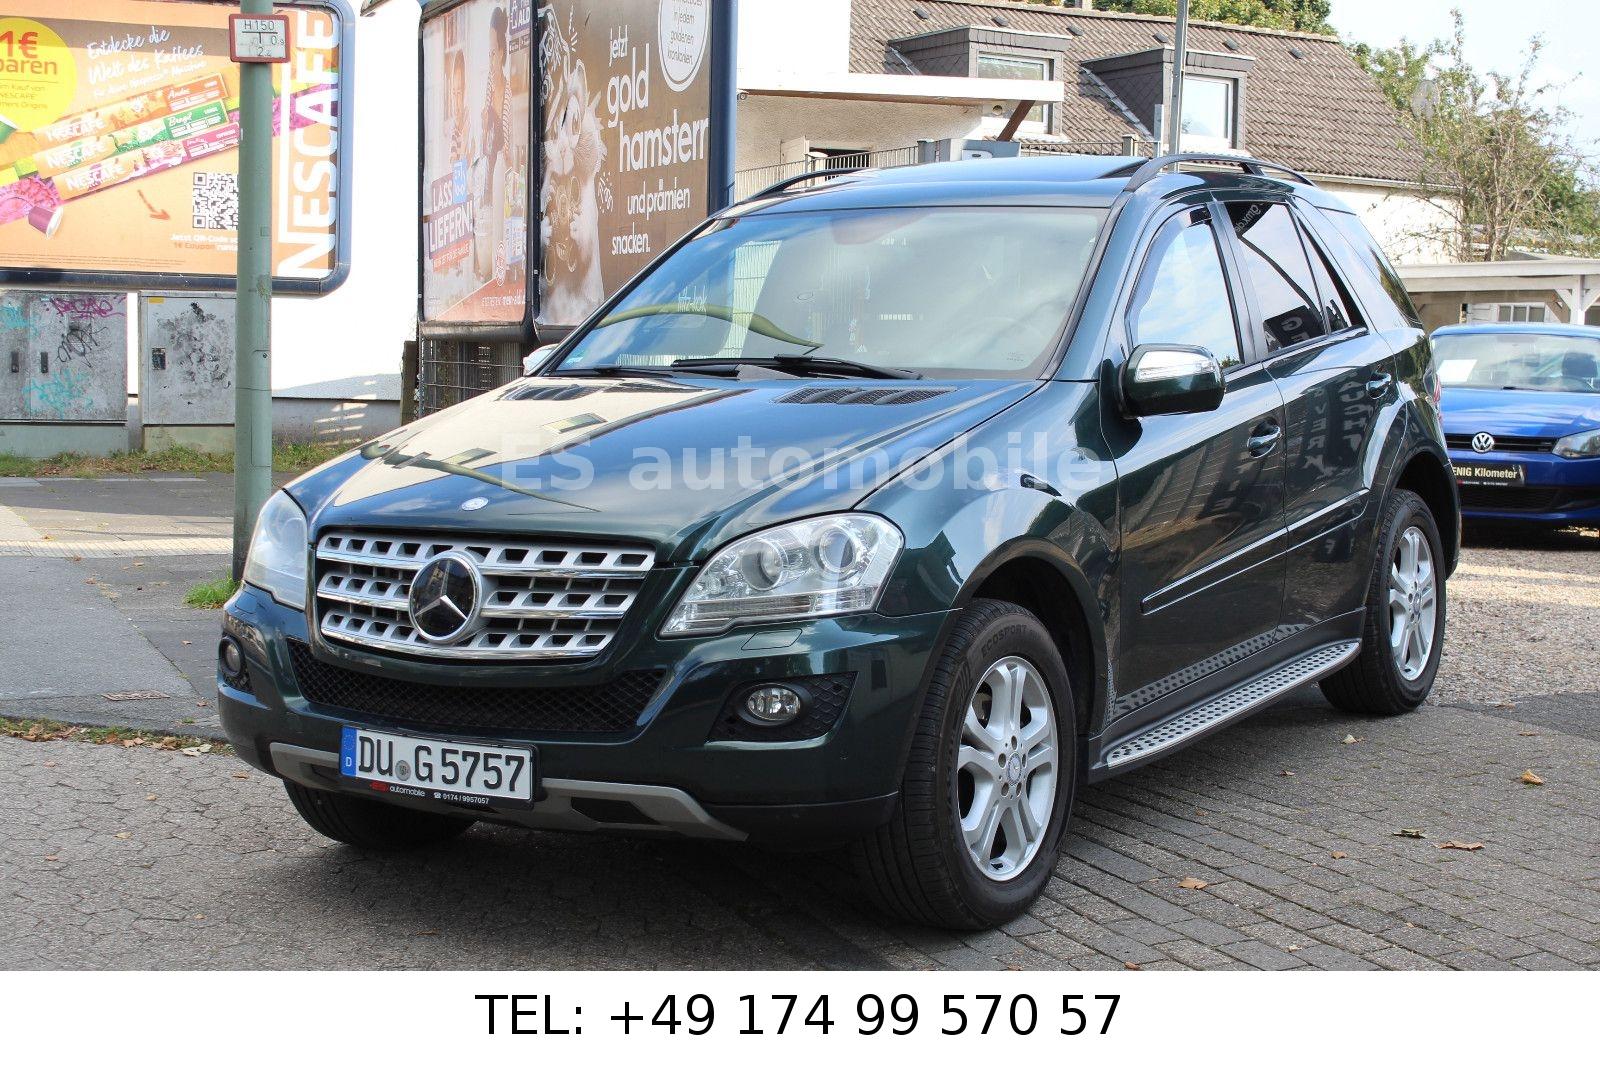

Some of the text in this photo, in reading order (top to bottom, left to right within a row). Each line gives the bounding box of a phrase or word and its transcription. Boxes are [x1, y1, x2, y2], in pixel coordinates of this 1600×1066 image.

[86, 25, 171, 59] Entdecke die
[608, 25, 628, 67] jetzt
[606, 43, 650, 128] gold
[619, 108, 709, 173] hamsterr
[627, 177, 690, 220] und prämien
[429, 200, 473, 253] LIEFERN!
[611, 222, 651, 256] snacken.
[1452, 466, 1518, 479] ENIG Kilometer
[358, 735, 525, 792] DU G 5757
[389, 785, 426, 797] automobile
